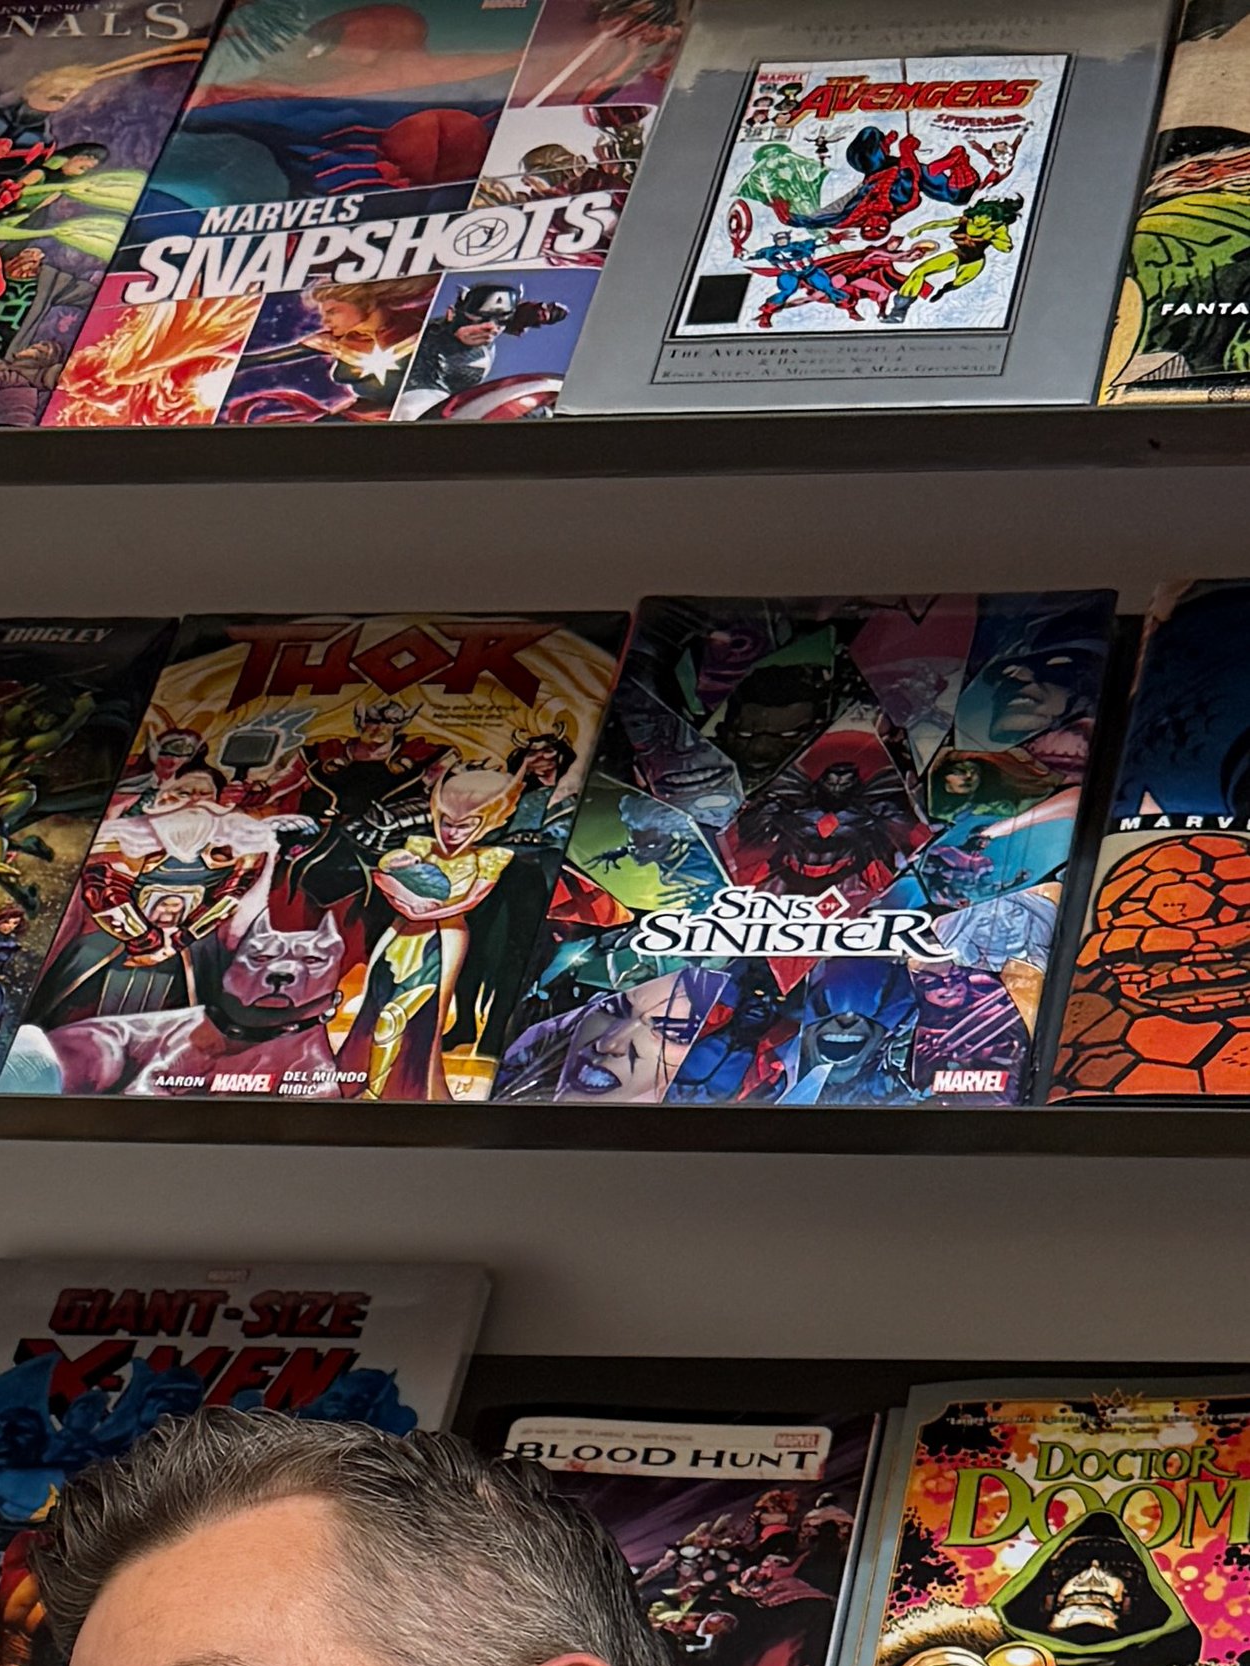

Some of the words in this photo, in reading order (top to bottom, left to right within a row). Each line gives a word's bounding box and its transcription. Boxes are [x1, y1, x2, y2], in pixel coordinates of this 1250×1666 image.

[786, 78, 1042, 127] AVENGERS
[198, 193, 365, 235] MARVELS
[124, 189, 615, 306] SNAPSHOTS
[2, 627, 114, 643] BAGLEY
[224, 622, 566, 714] THOR
[711, 889, 814, 921] SINS
[635, 911, 951, 958] SINISTER
[155, 1076, 205, 1088] AARON
[210, 1073, 276, 1093] MARVEL
[283, 1071, 308, 1082] DEL
[312, 1071, 368, 1083] MUNDO
[933, 1070, 1009, 1093] MARVEL
[49, 1288, 372, 1339] GIANT-SIZE
[516, 1441, 676, 1467] BLOOD
[689, 1449, 818, 1470] HUNT
[774, 1433, 820, 1448] MARVEL
[1033, 1440, 1241, 1482] DOCTOR
[941, 1467, 1250, 1549] DOOM
